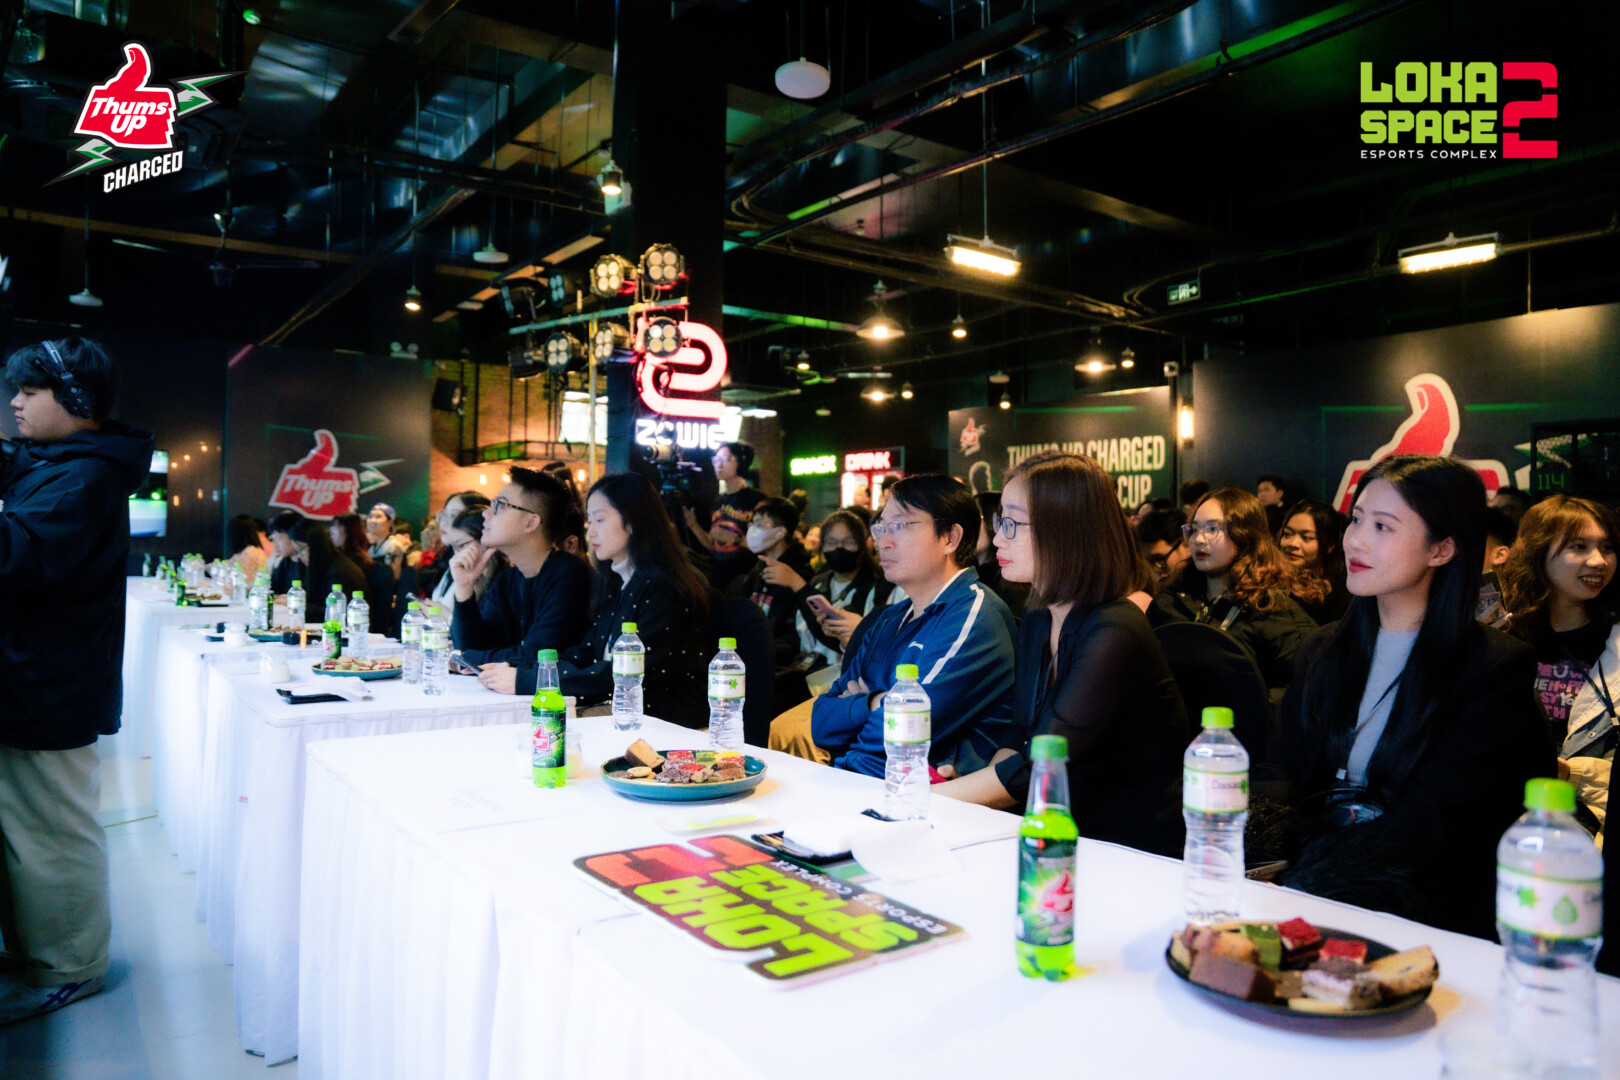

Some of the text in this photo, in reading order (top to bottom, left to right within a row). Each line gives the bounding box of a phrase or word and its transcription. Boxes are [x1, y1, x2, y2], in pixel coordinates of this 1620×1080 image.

[284, 474, 353, 493] Thums
[845, 451, 890, 471] DRINK
[1117, 474, 1152, 509] CUP
[710, 864, 918, 950] SPACE
[771, 859, 948, 935] ESPORTS COMPLEX
[634, 876, 854, 976] LOKA
